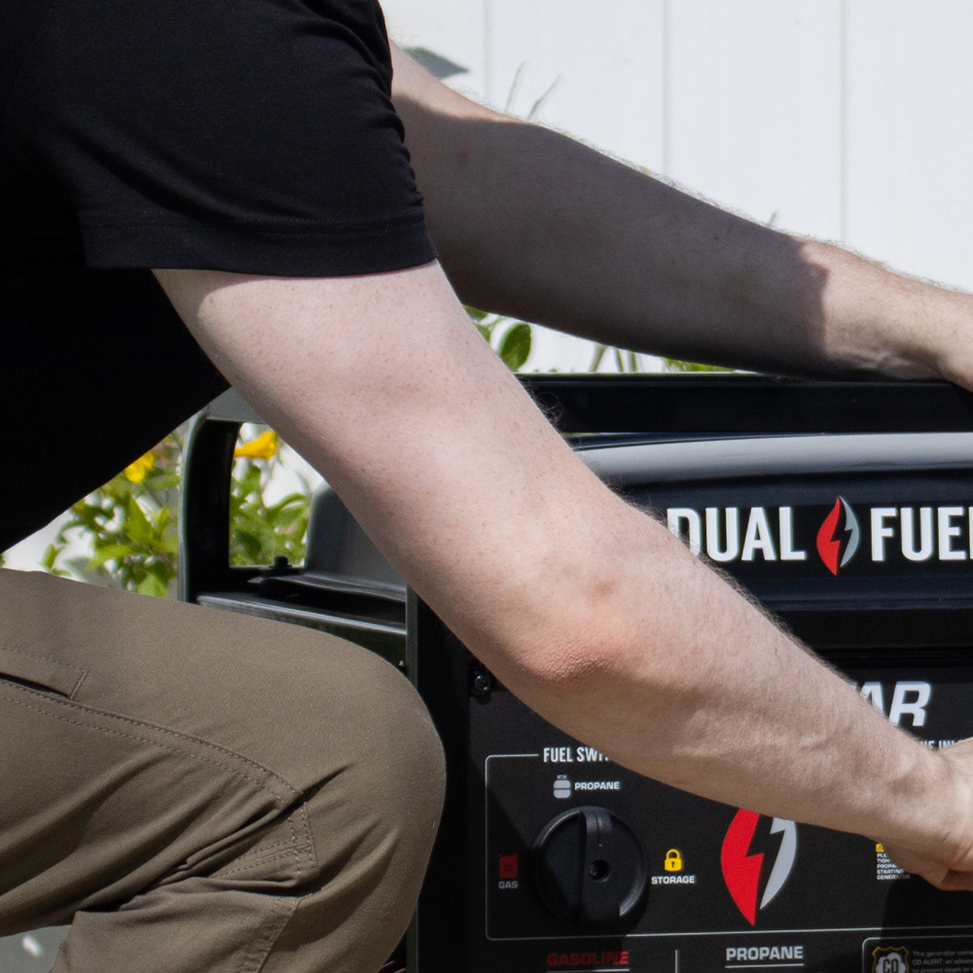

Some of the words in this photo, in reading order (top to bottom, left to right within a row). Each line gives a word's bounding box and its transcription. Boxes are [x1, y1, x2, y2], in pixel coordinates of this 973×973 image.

[667, 506, 806, 562] DUAL
[543, 747, 573, 763] FUEL
[576, 746, 608, 762] SWI
[574, 781, 620, 791] PROPANE
[498, 880, 518, 889] GAS
[651, 875, 695, 885] STORAGE
[547, 951, 629, 967] GASOLINE
[726, 946, 804, 961] PROPANE
